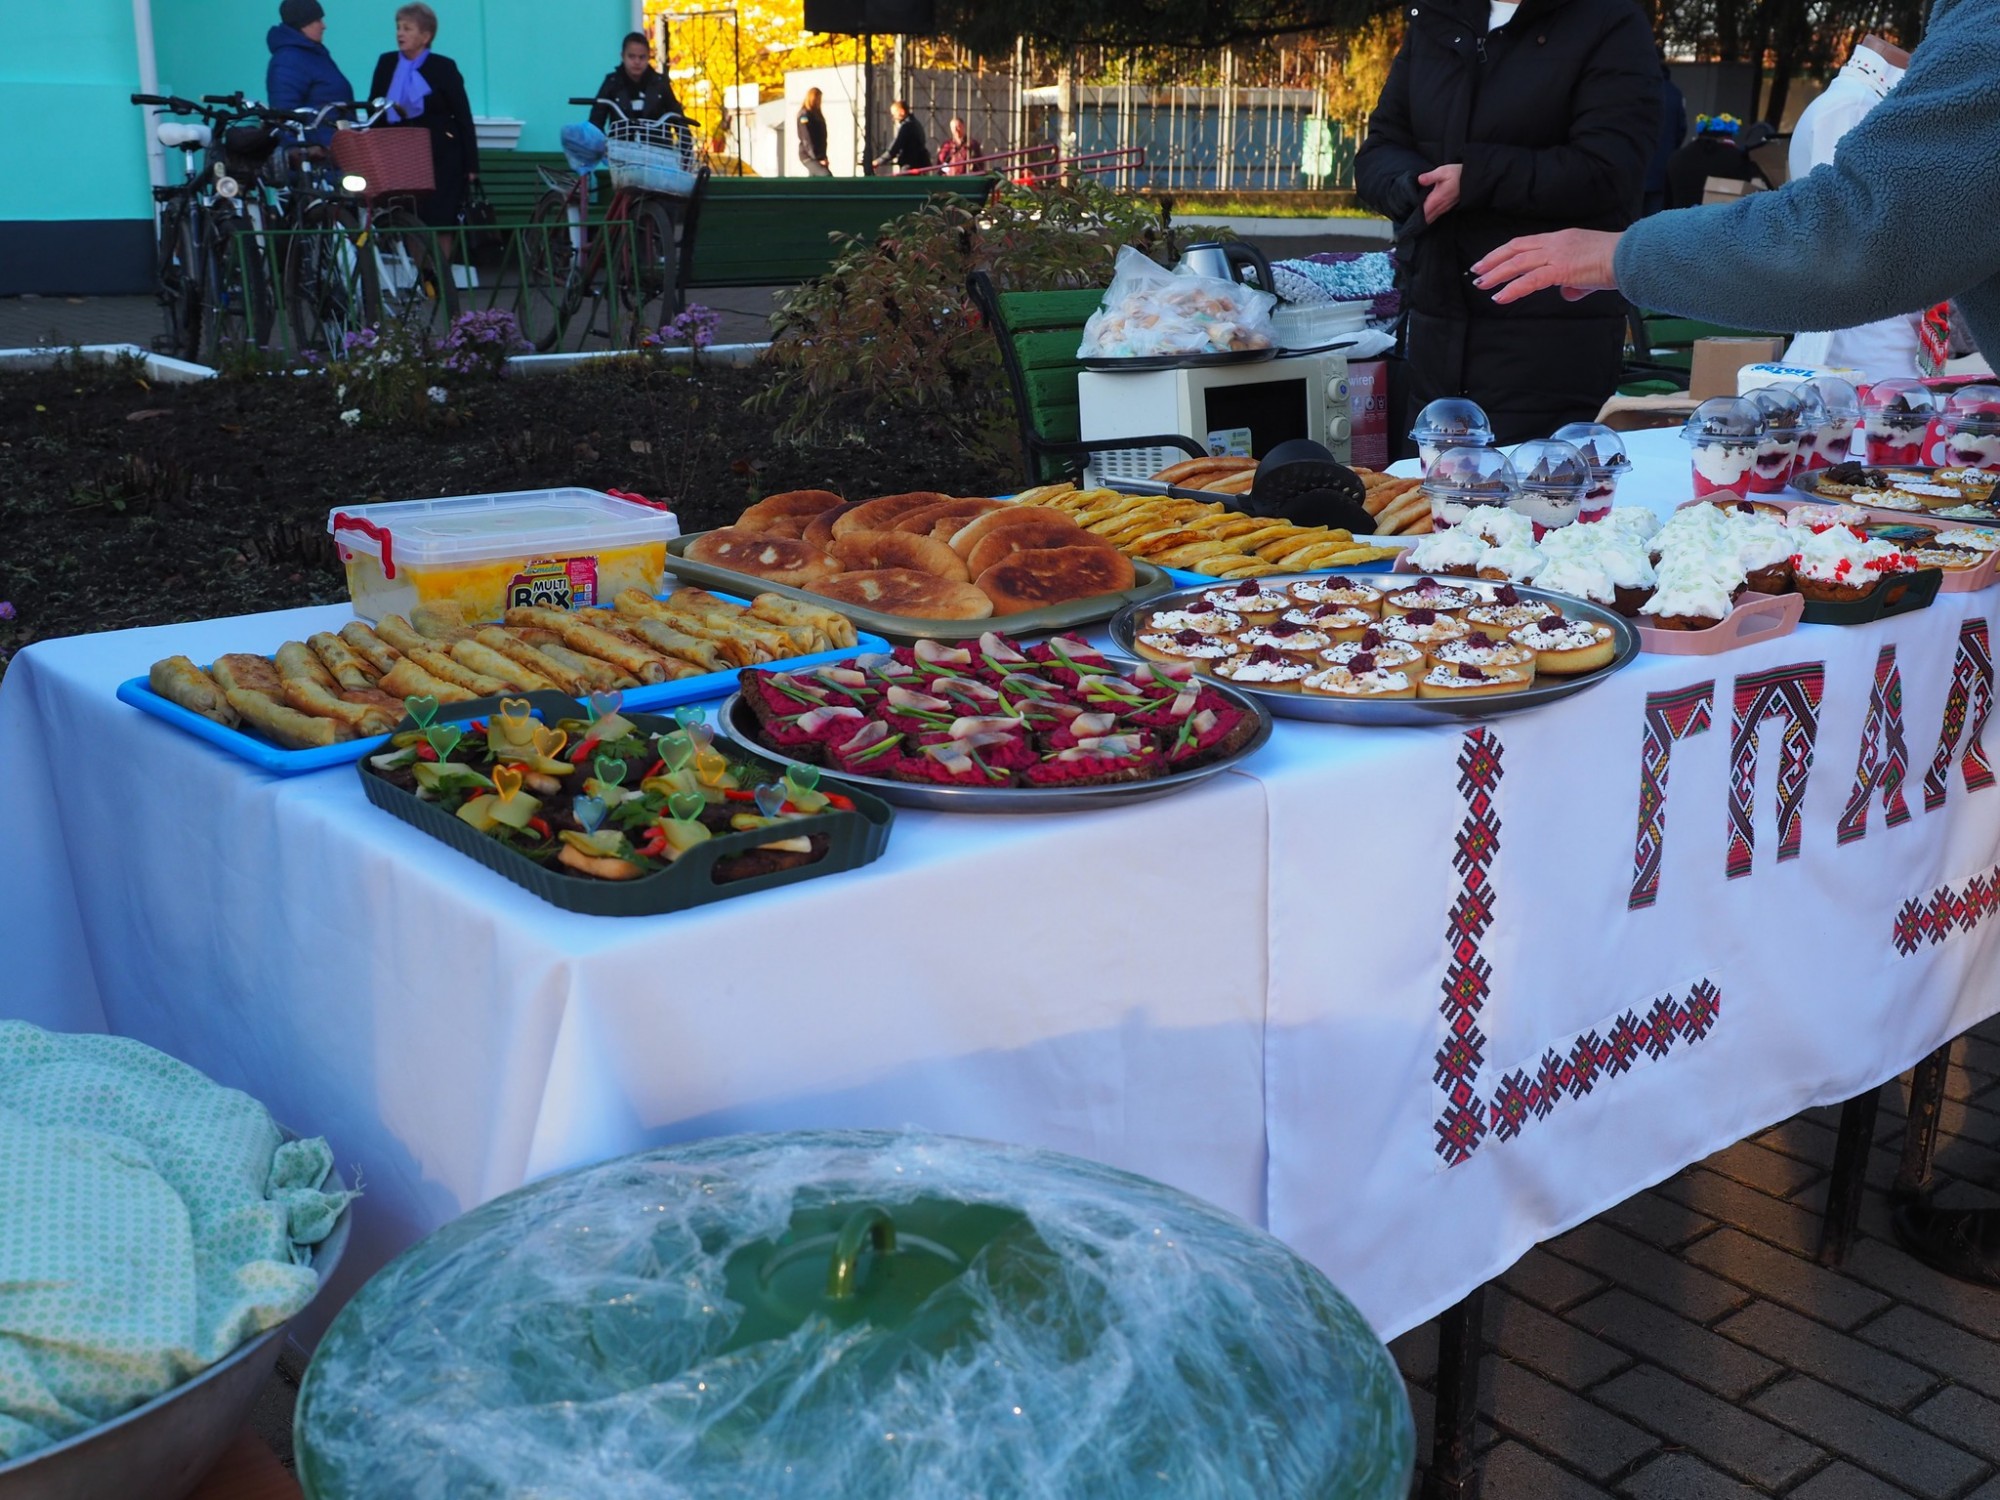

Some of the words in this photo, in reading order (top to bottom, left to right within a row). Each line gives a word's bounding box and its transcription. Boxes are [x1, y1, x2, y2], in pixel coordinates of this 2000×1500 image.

[533, 579, 567, 593] MULTI
[514, 588, 570, 610] BOX
[1627, 617, 1997, 912] ГПАЛ
